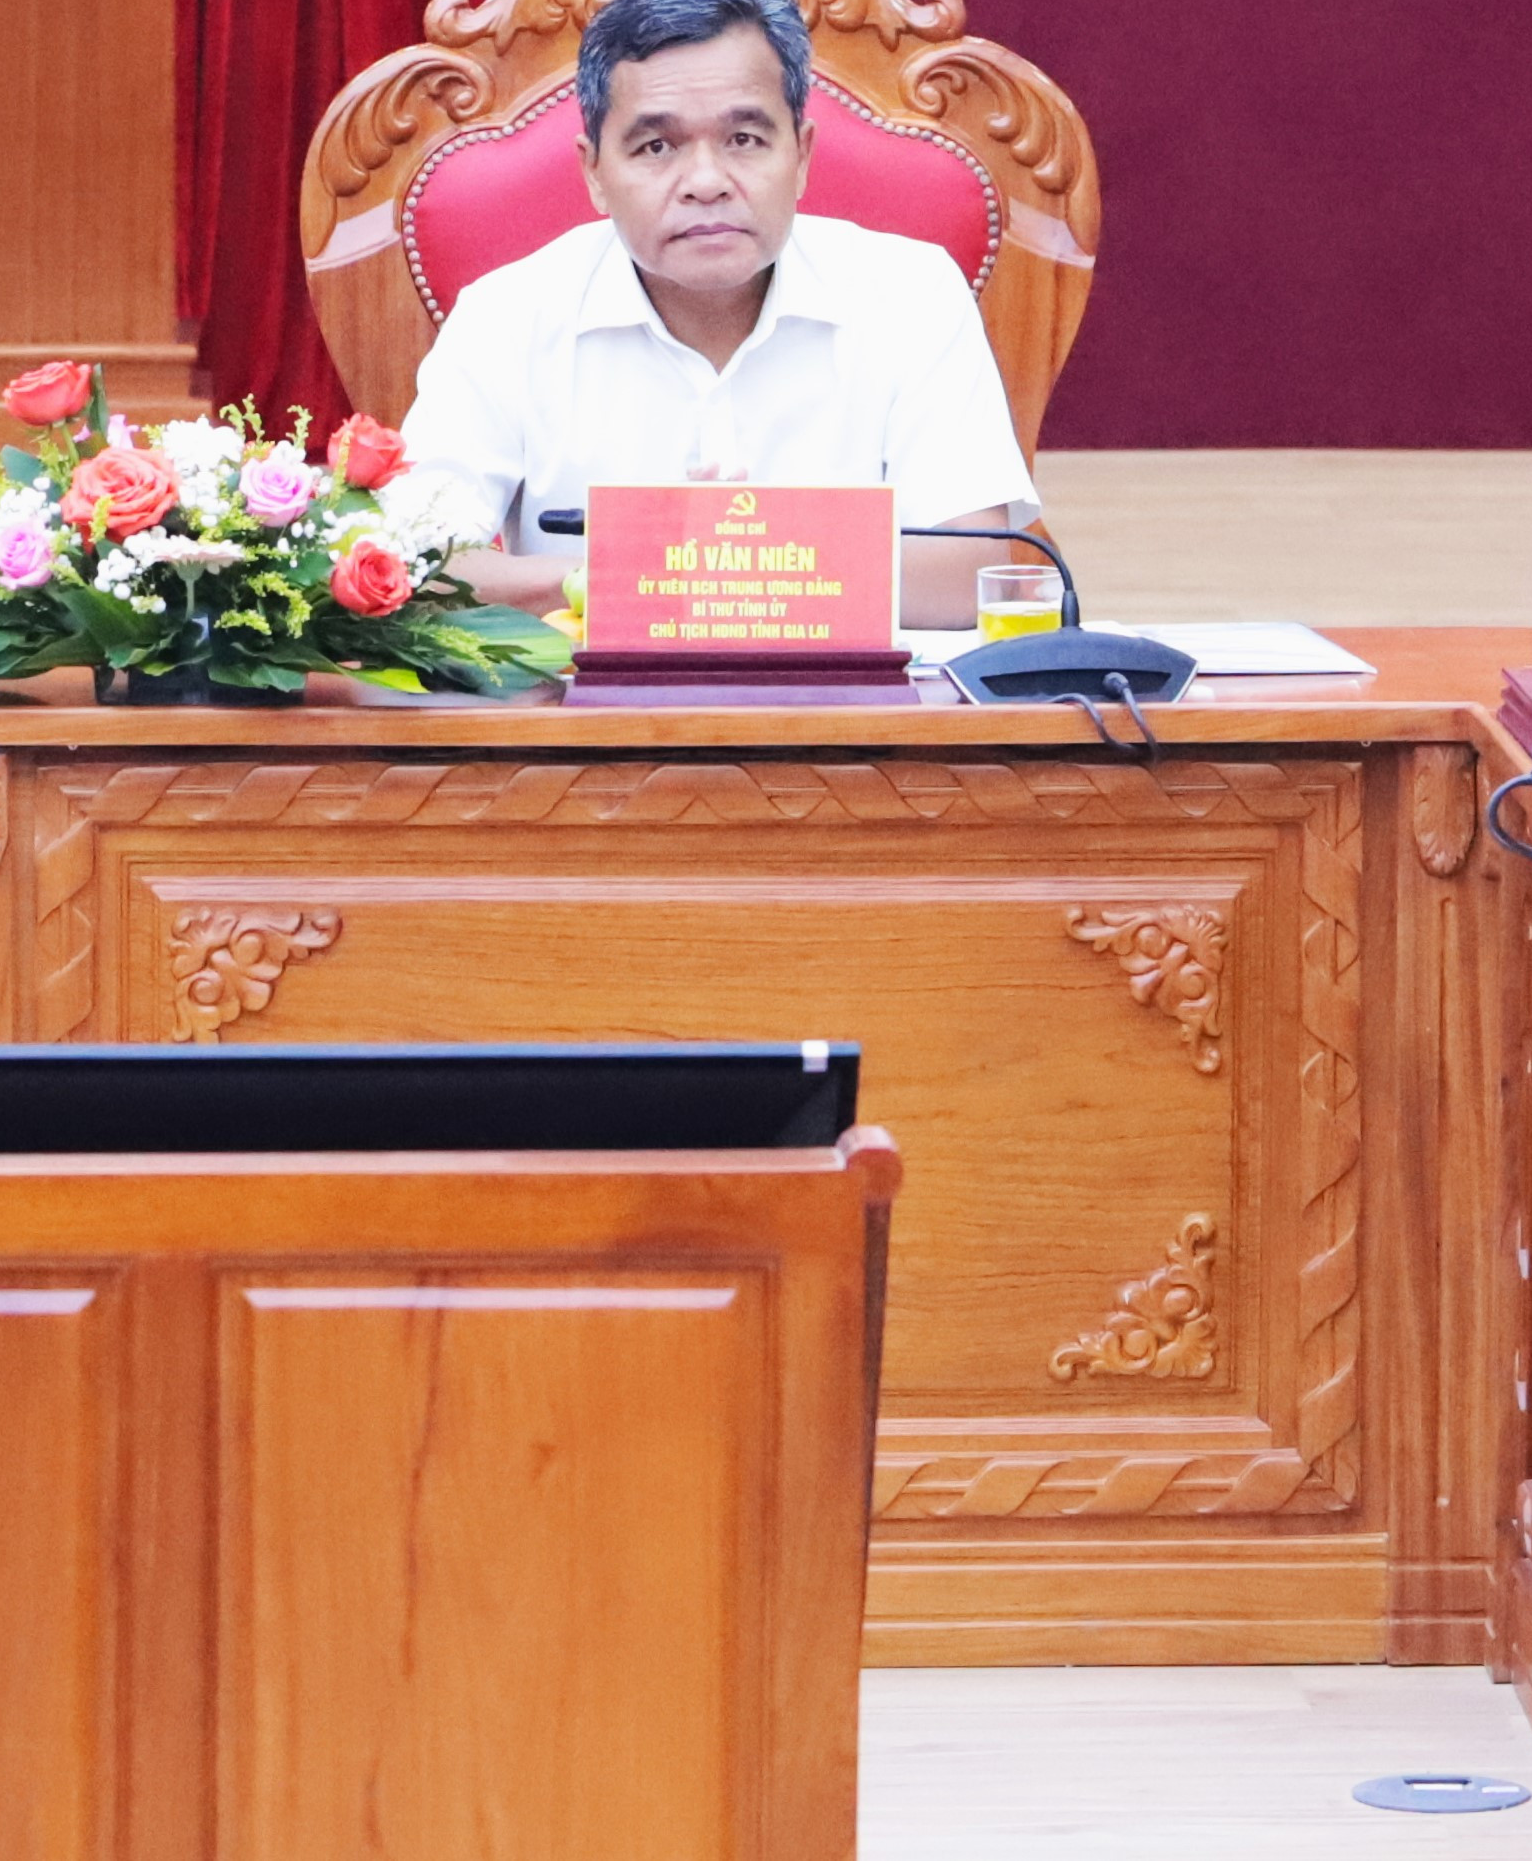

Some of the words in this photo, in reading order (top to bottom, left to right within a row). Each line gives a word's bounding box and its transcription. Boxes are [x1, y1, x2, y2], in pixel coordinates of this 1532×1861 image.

[665, 538, 698, 571] HỒ
[704, 541, 752, 571] VĂN
[758, 541, 815, 571] NIÊN
[638, 575, 655, 595] ỦY
[658, 578, 688, 595] VIÊN
[721, 581, 764, 595] TRUNG
[737, 598, 767, 617] TỈNH
[770, 597, 788, 617] ỦY
[649, 618, 676, 638] CHỦ
[679, 624, 708, 641] TỊCH
[751, 619, 780, 638] TỈNH
[783, 625, 806, 639] GIA
[809, 625, 830, 639] LAI
